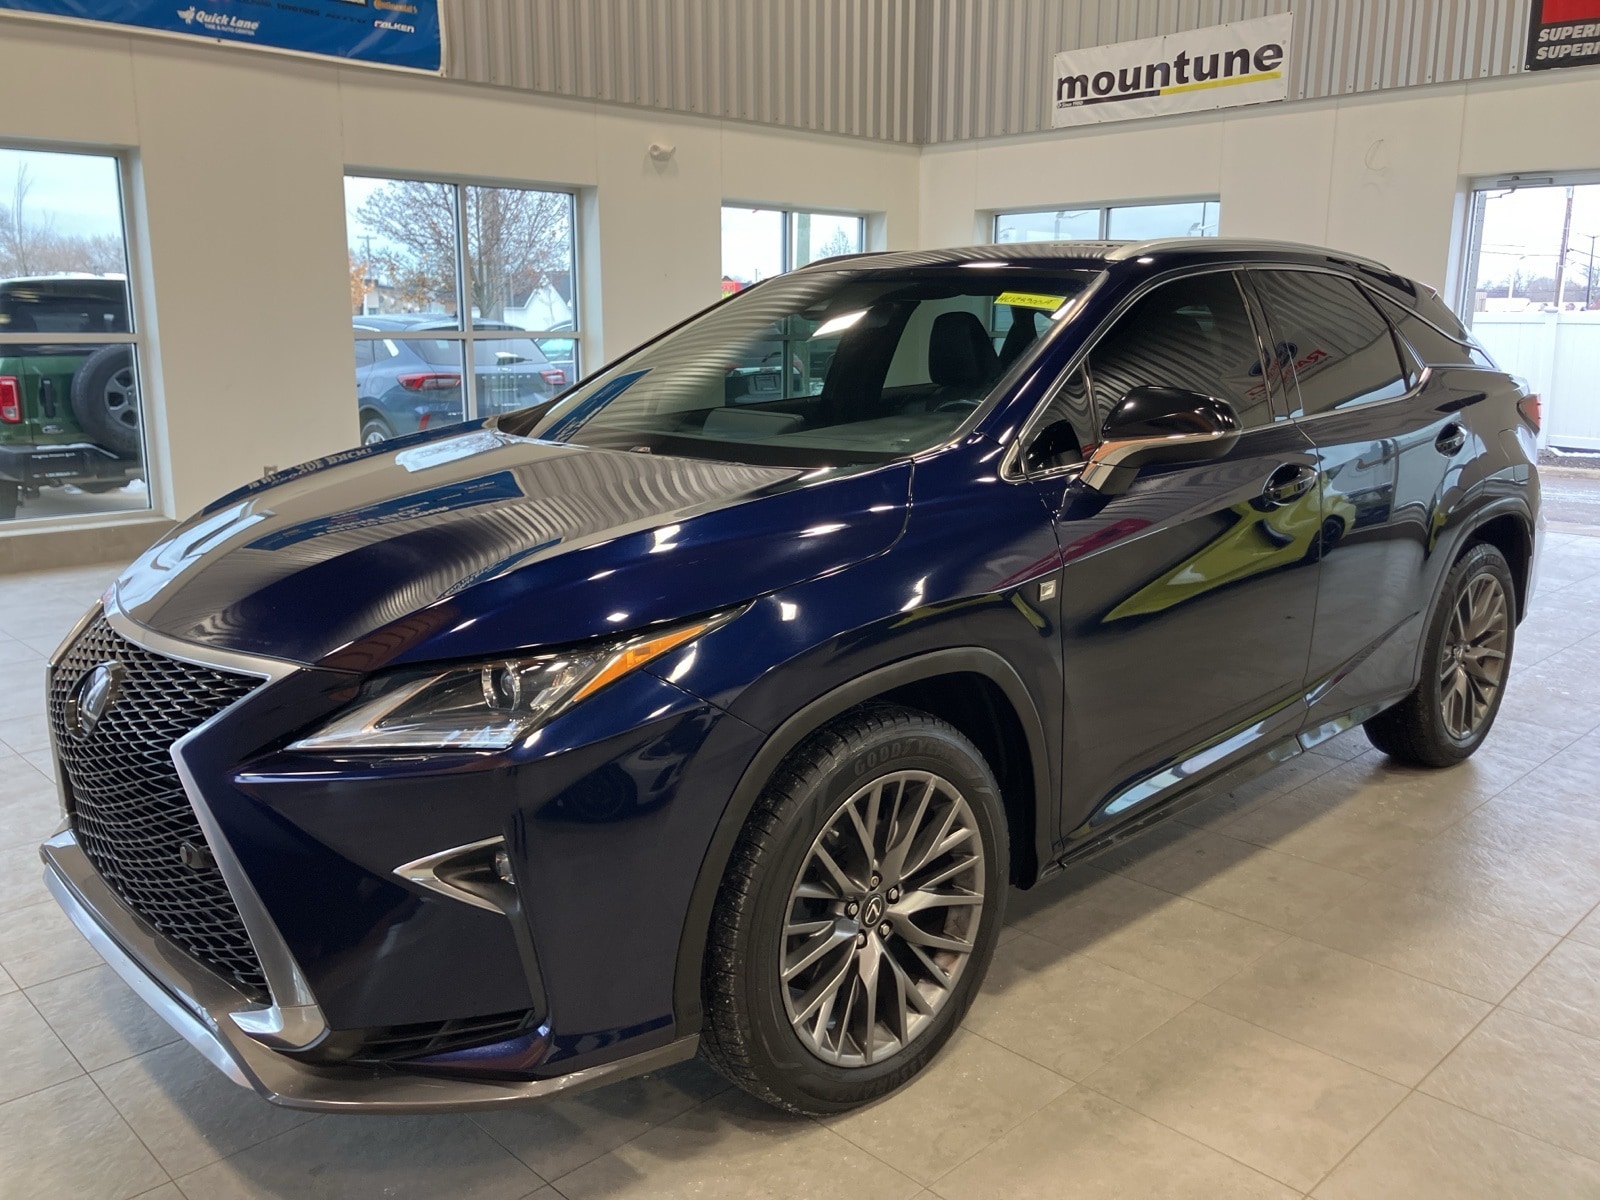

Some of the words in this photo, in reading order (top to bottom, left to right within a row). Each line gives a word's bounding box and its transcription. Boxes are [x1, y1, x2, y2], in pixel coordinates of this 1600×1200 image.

[195, 10, 229, 25] Quick
[229, 15, 259, 30] Lane
[374, 20, 415, 33] FALKEN
[1056, 43, 1284, 101] mountune
